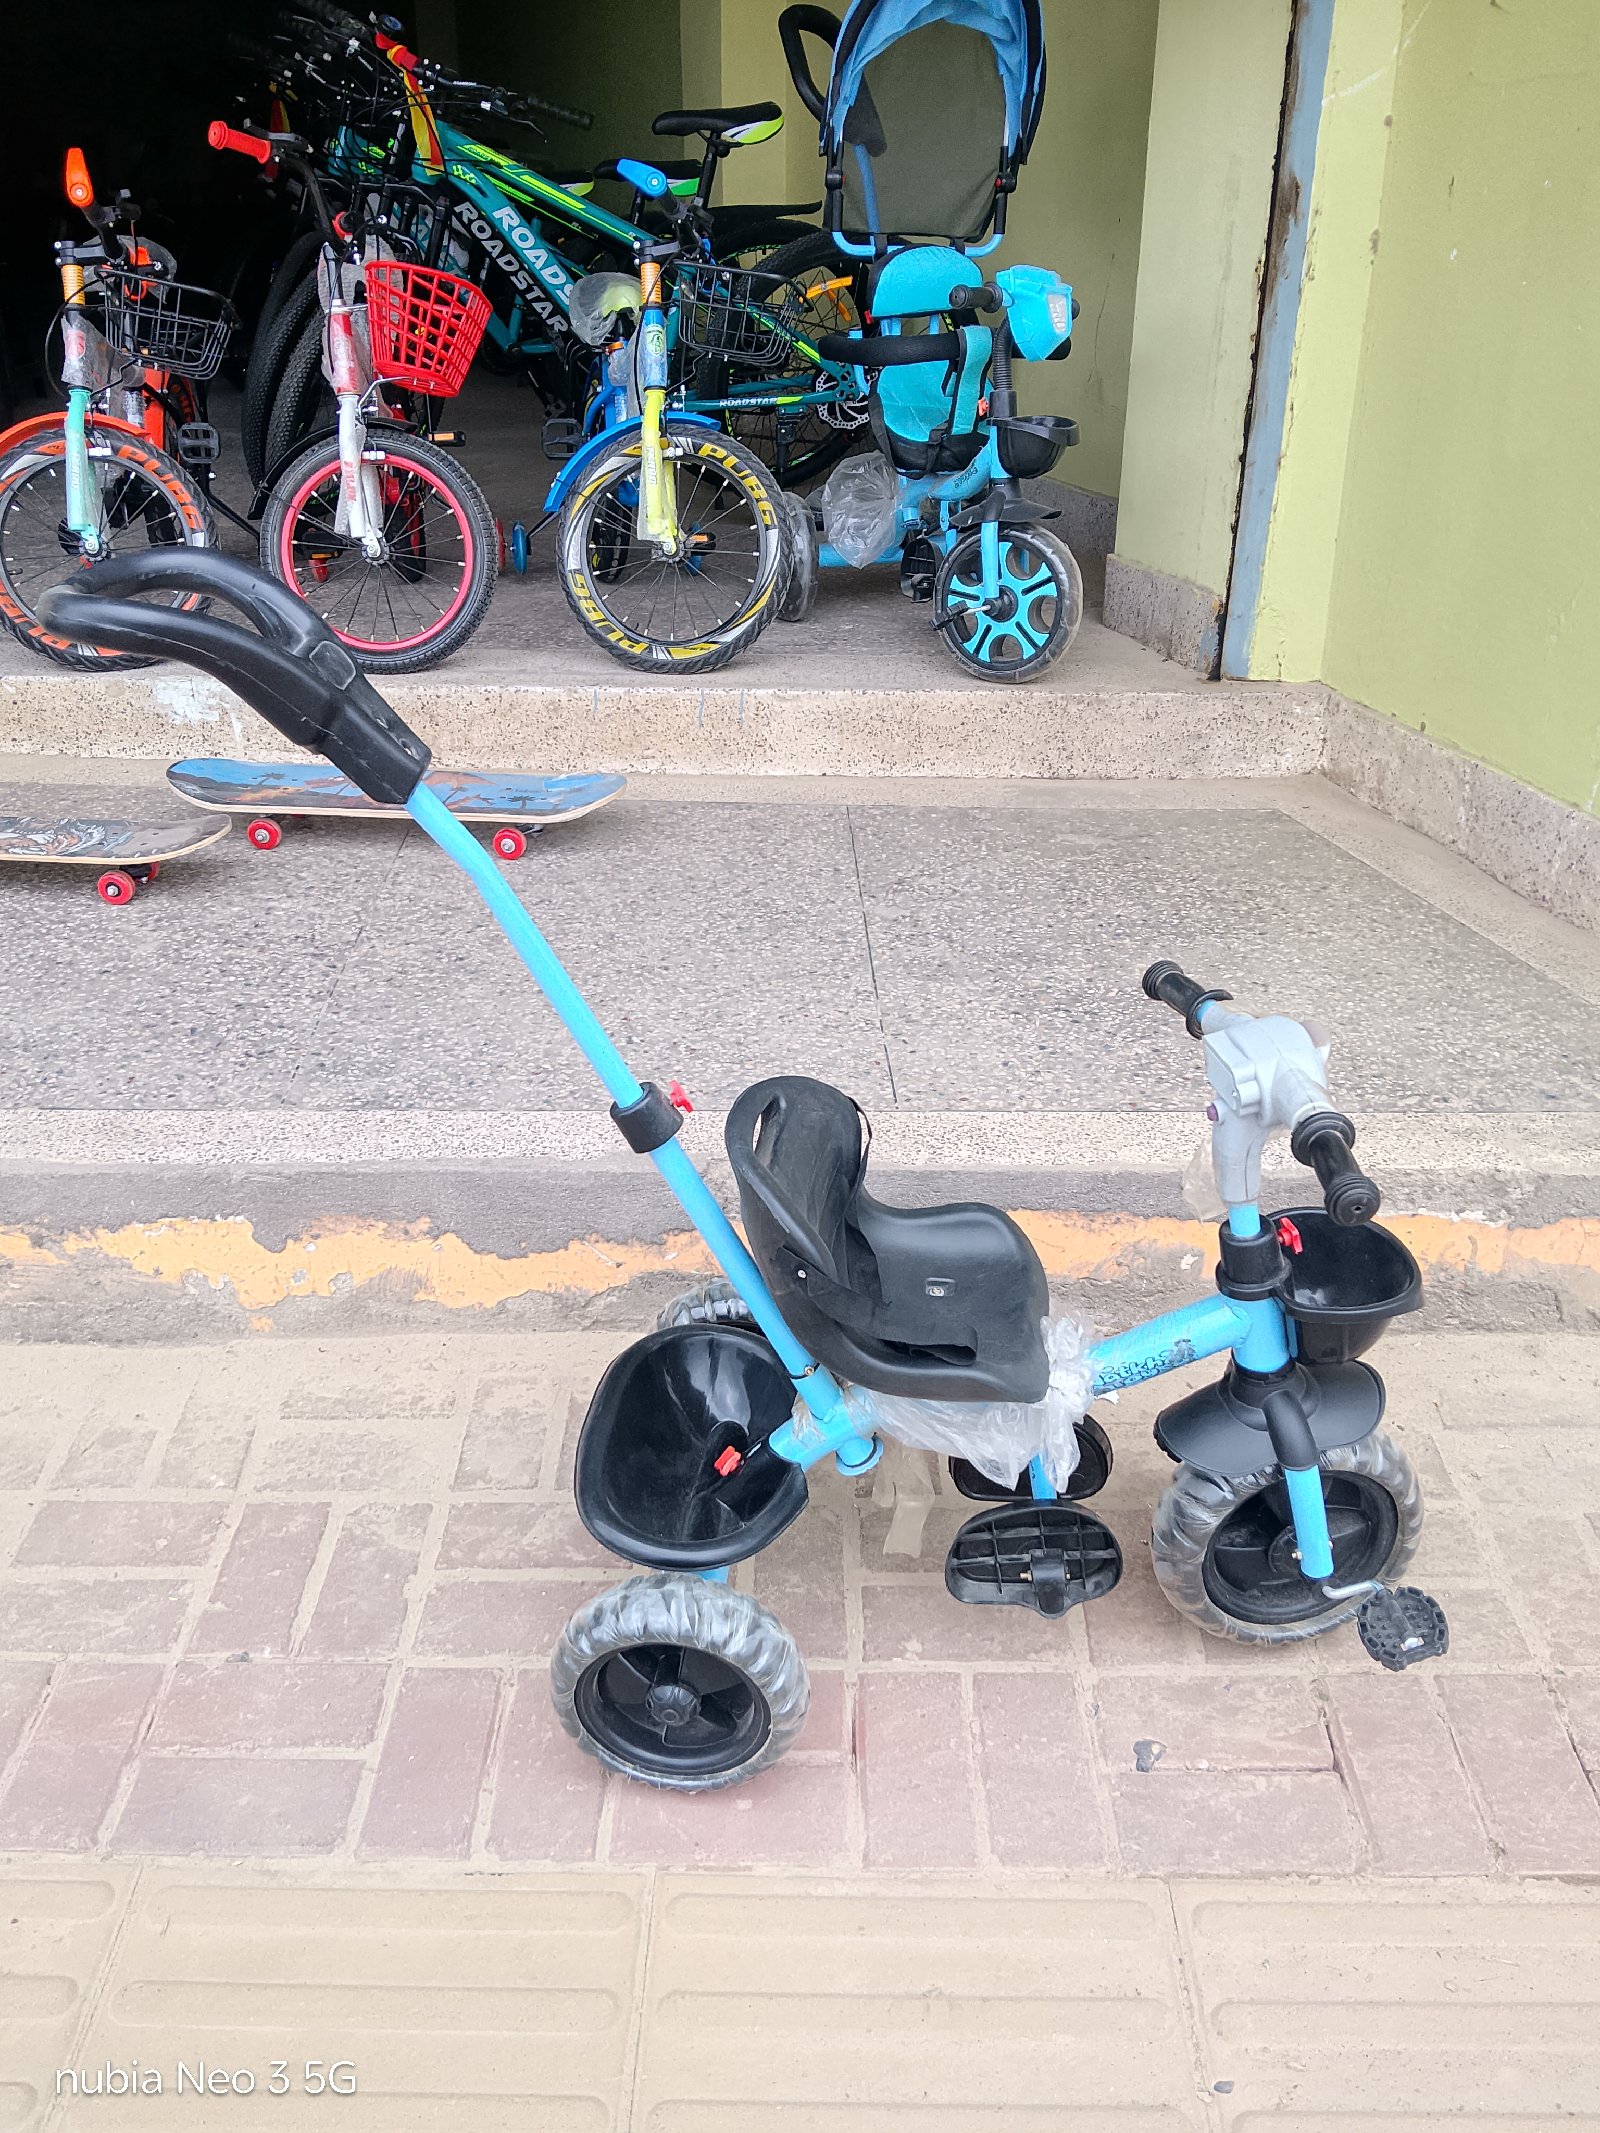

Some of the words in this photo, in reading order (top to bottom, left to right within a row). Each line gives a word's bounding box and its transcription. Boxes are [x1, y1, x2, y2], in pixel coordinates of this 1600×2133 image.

[453, 201, 569, 333] ROADSTAR
[491, 205, 574, 306] ROADS
[720, 396, 778, 407] ROADSTAR
[117, 444, 205, 530] PUBG
[698, 442, 778, 527] PUBG
[568, 571, 650, 655] PUBG
